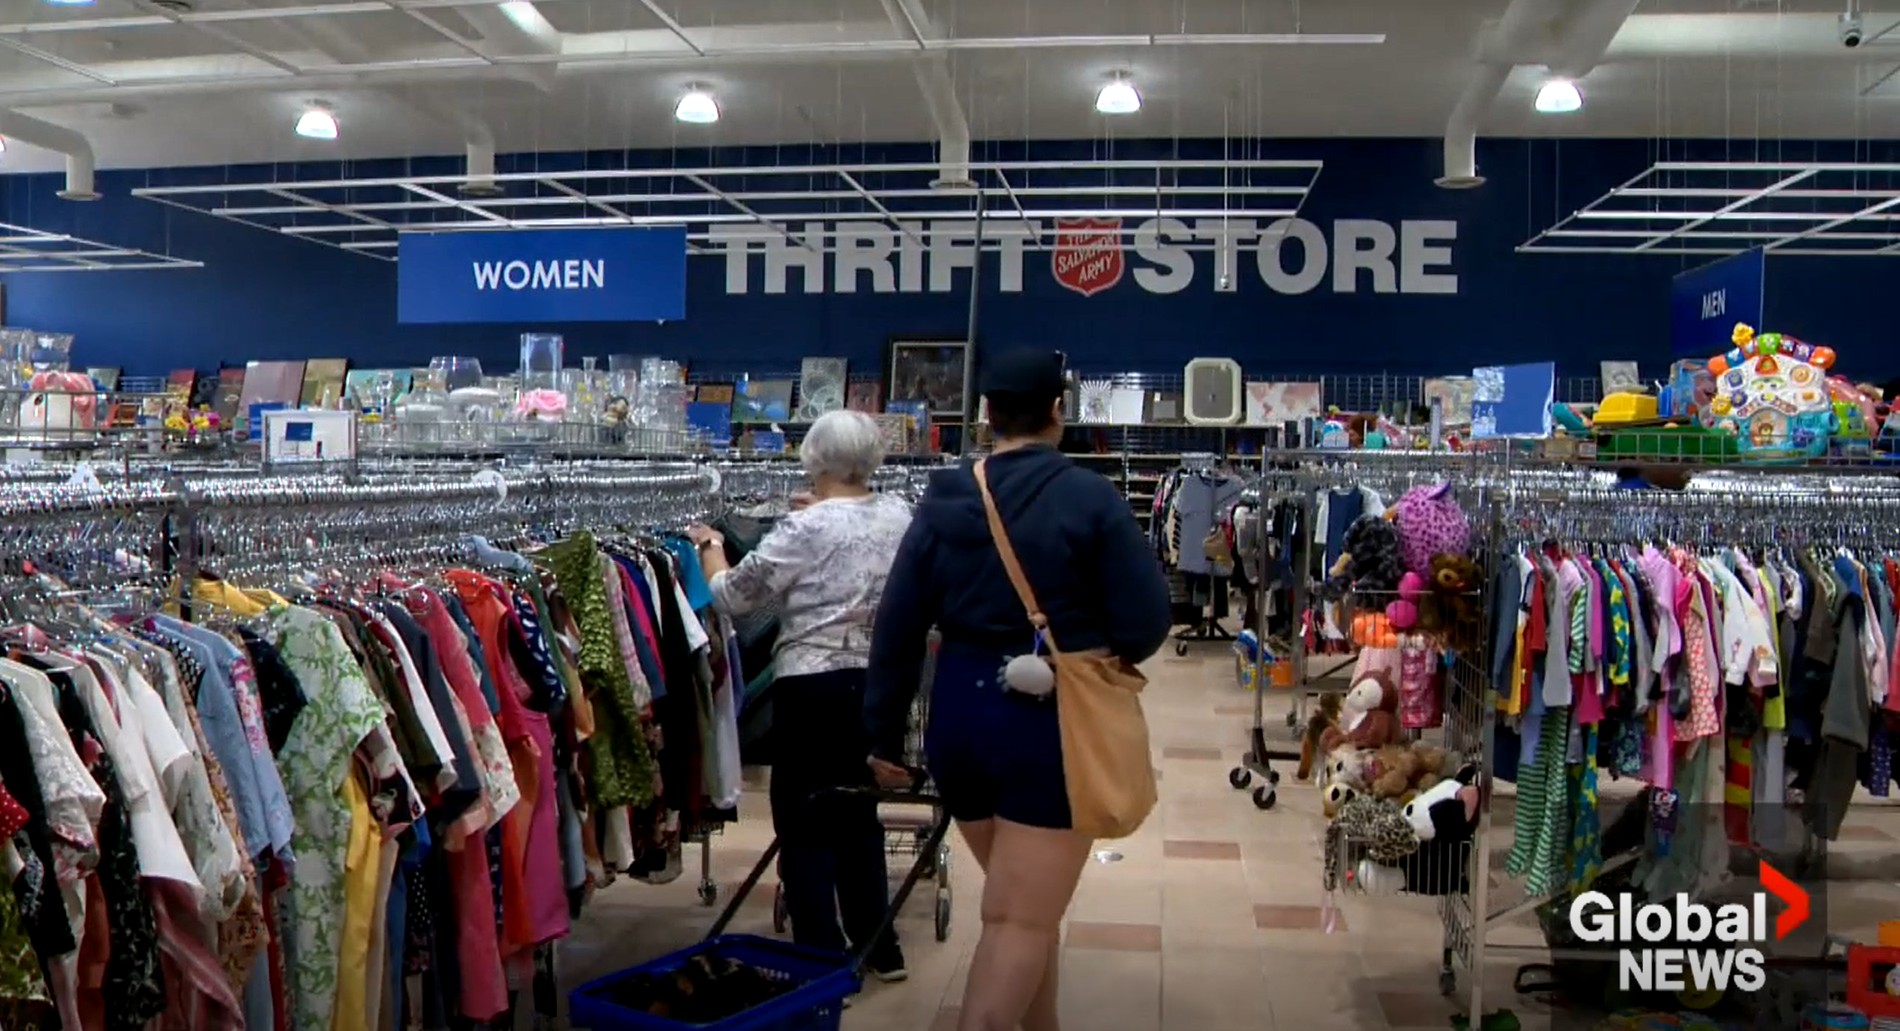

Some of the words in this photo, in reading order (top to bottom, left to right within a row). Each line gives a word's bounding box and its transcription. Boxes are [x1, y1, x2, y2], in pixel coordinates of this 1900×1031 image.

[709, 220, 1042, 294] THRIFT
[1133, 217, 1458, 294] STORE
[1078, 251, 1114, 284] ARMY
[473, 259, 604, 290] WOMEN
[1701, 287, 1726, 320] MEN
